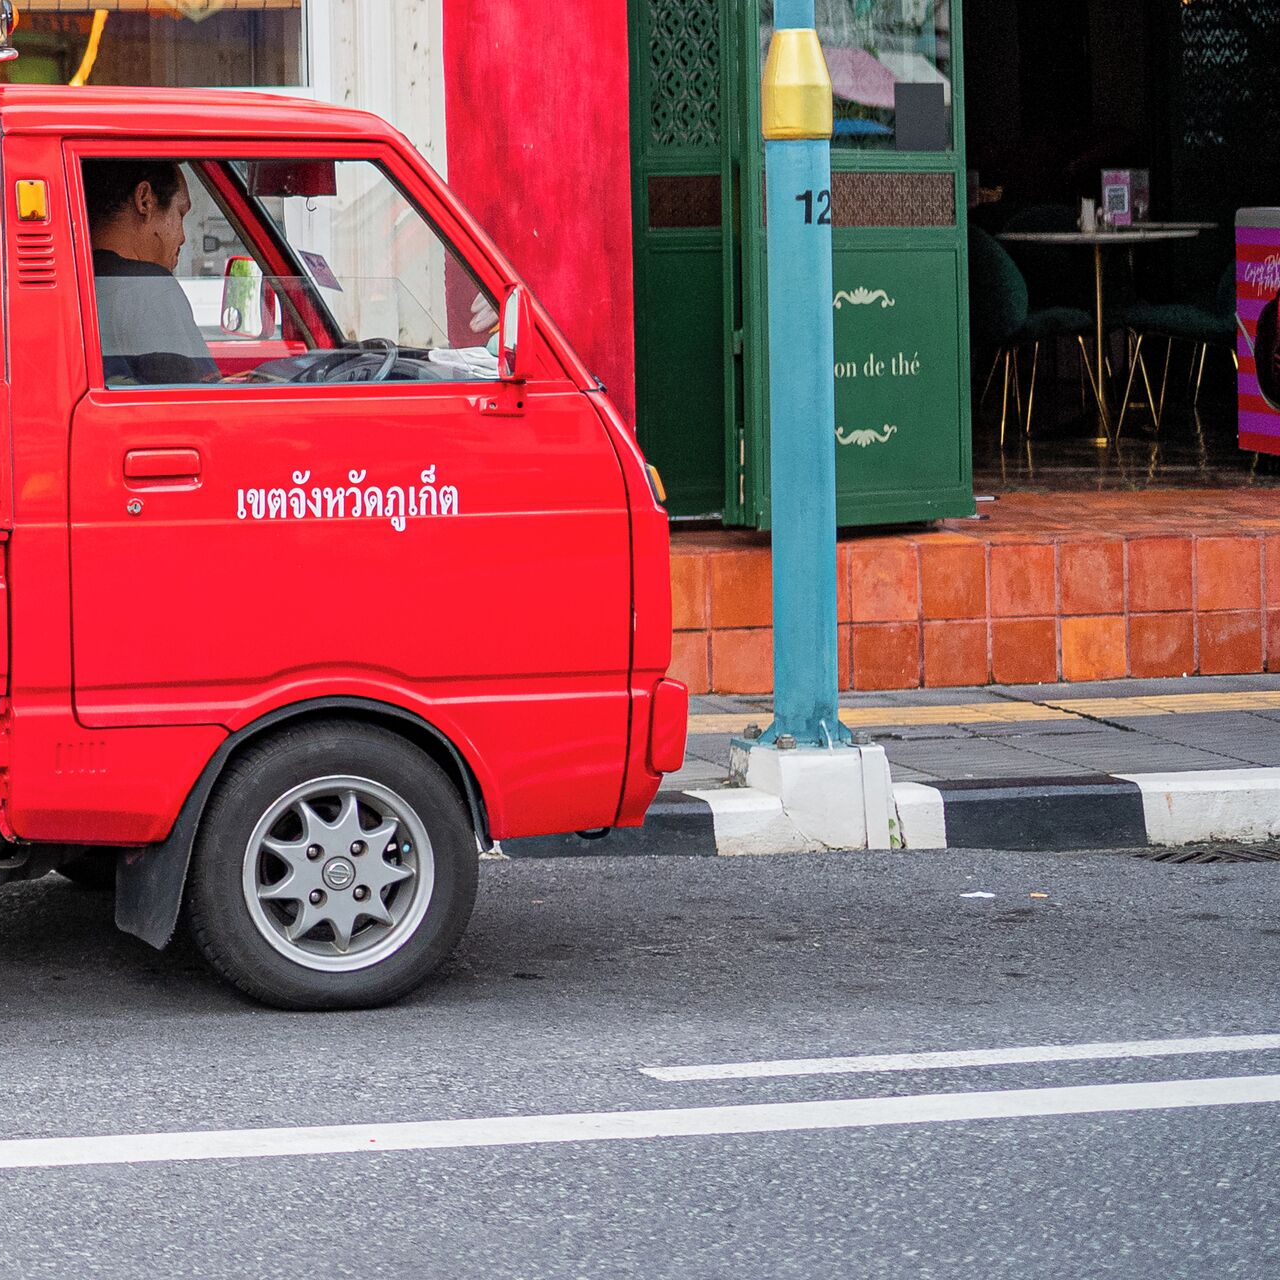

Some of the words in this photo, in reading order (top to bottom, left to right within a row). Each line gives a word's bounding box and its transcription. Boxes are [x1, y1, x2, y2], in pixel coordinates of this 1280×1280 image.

[863, 352, 885, 377] de
[891, 351, 920, 376] thé
[236, 464, 459, 532] เขตจังหวัดภูเก็ต
